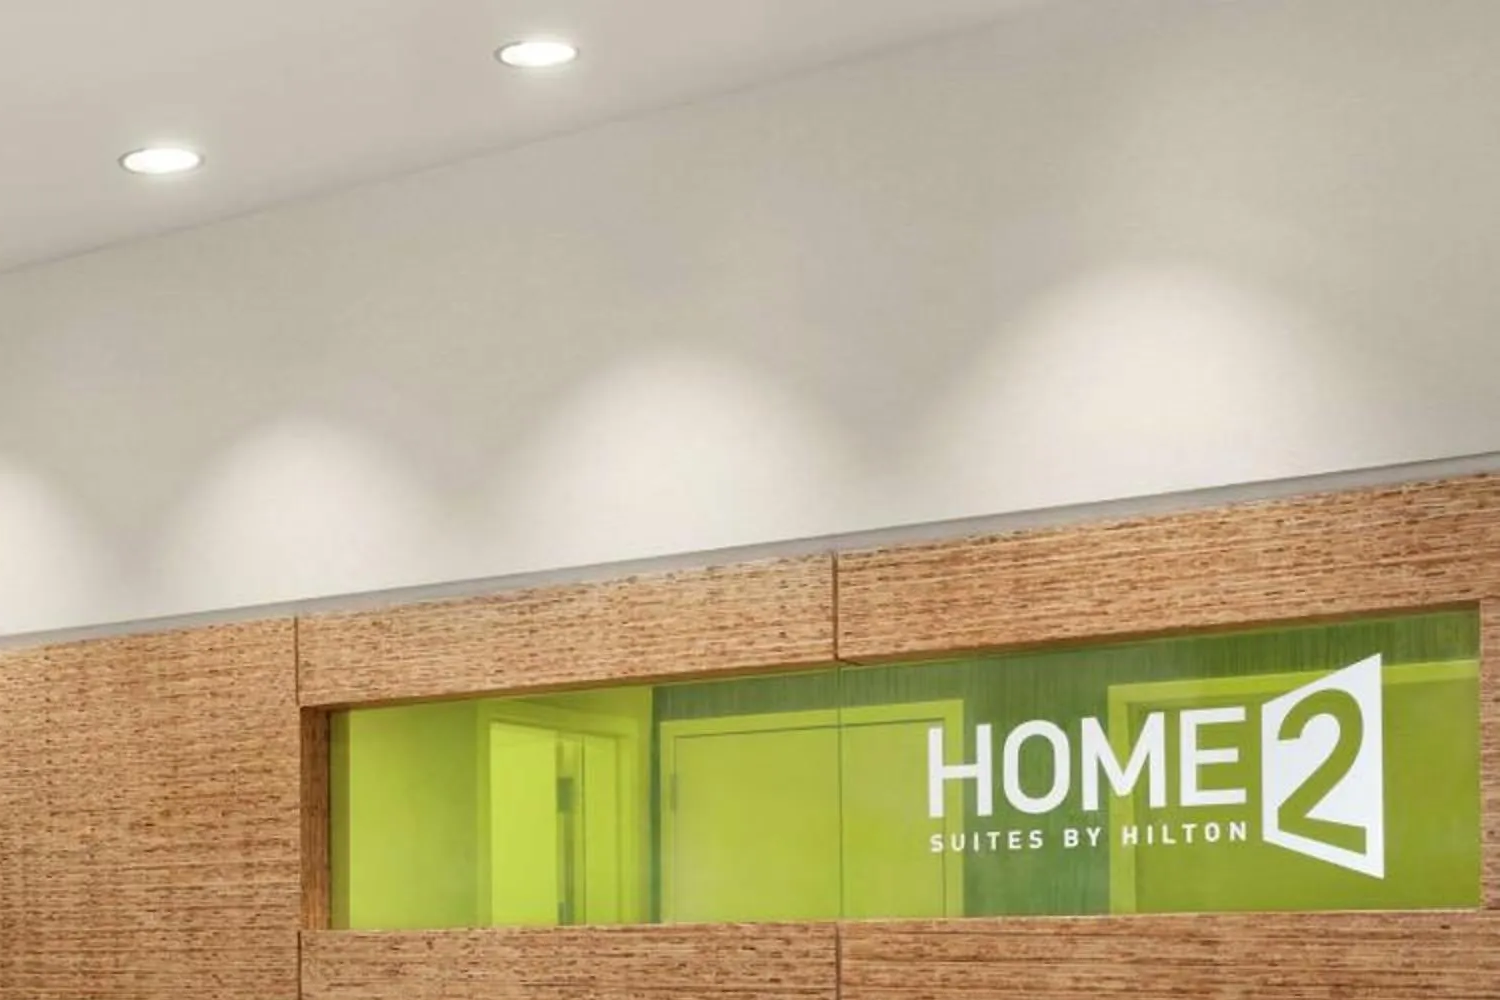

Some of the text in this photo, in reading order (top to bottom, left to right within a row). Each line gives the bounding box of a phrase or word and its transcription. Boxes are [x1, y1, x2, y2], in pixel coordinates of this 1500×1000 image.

[930, 821, 1247, 853] SUITES BY HILTON
